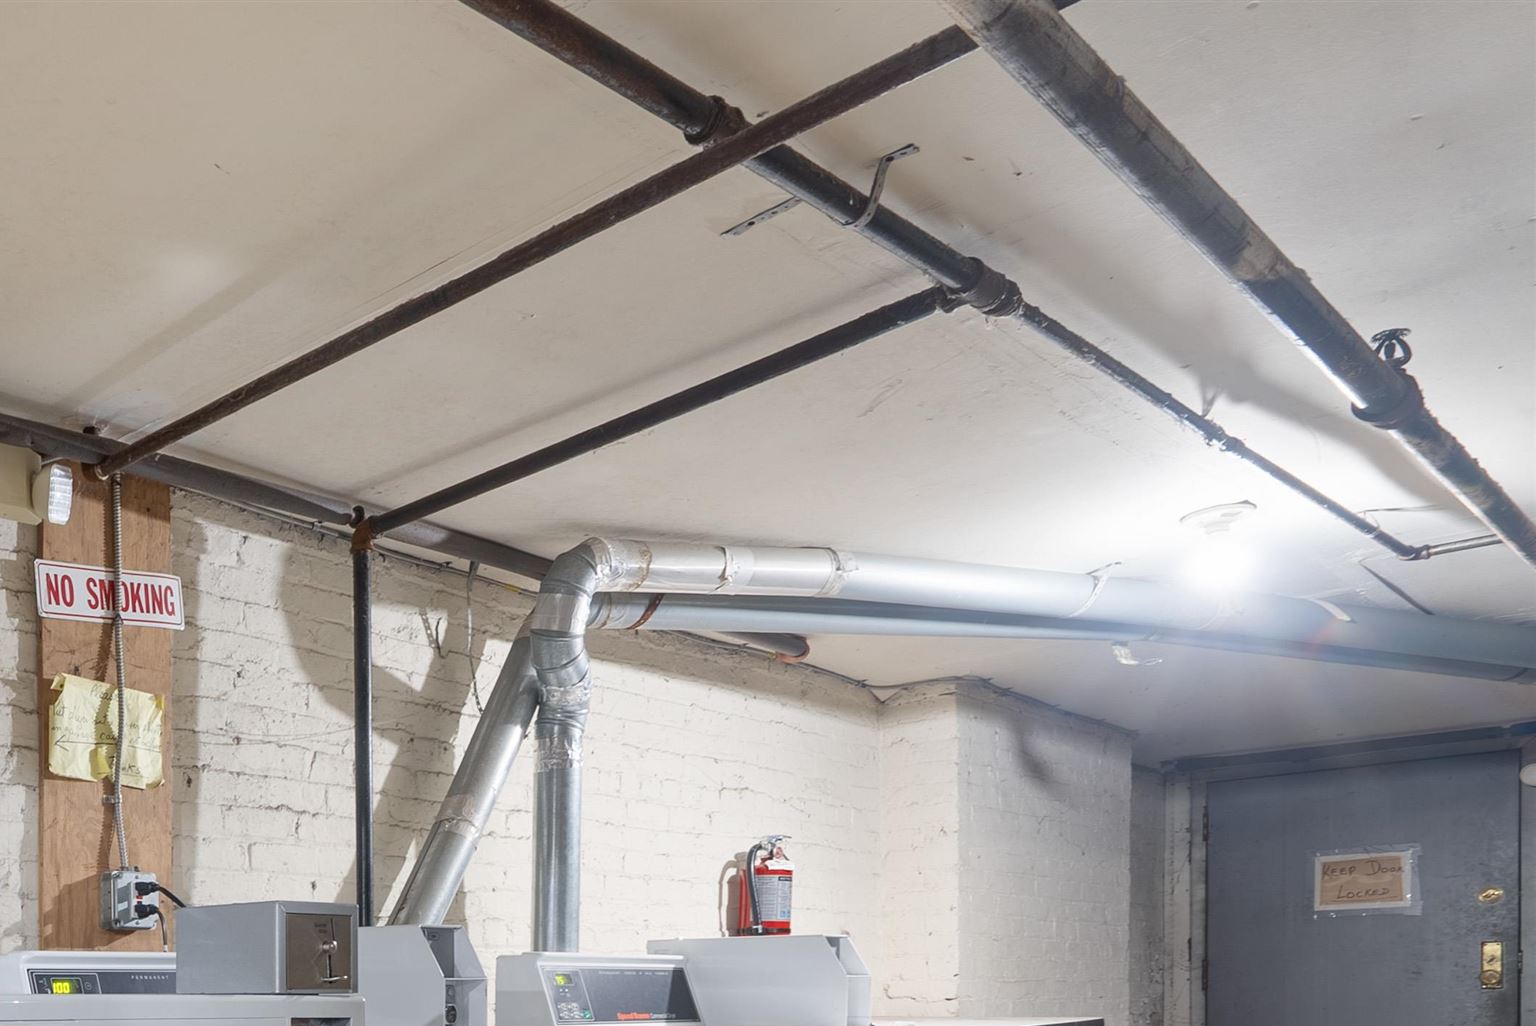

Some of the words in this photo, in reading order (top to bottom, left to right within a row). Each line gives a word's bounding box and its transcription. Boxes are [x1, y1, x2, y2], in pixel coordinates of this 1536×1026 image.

[46, 573, 74, 608] NO
[1321, 862, 1357, 881] KEEP
[1365, 860, 1405, 877] DOOR
[1336, 885, 1391, 900] LOCKED
